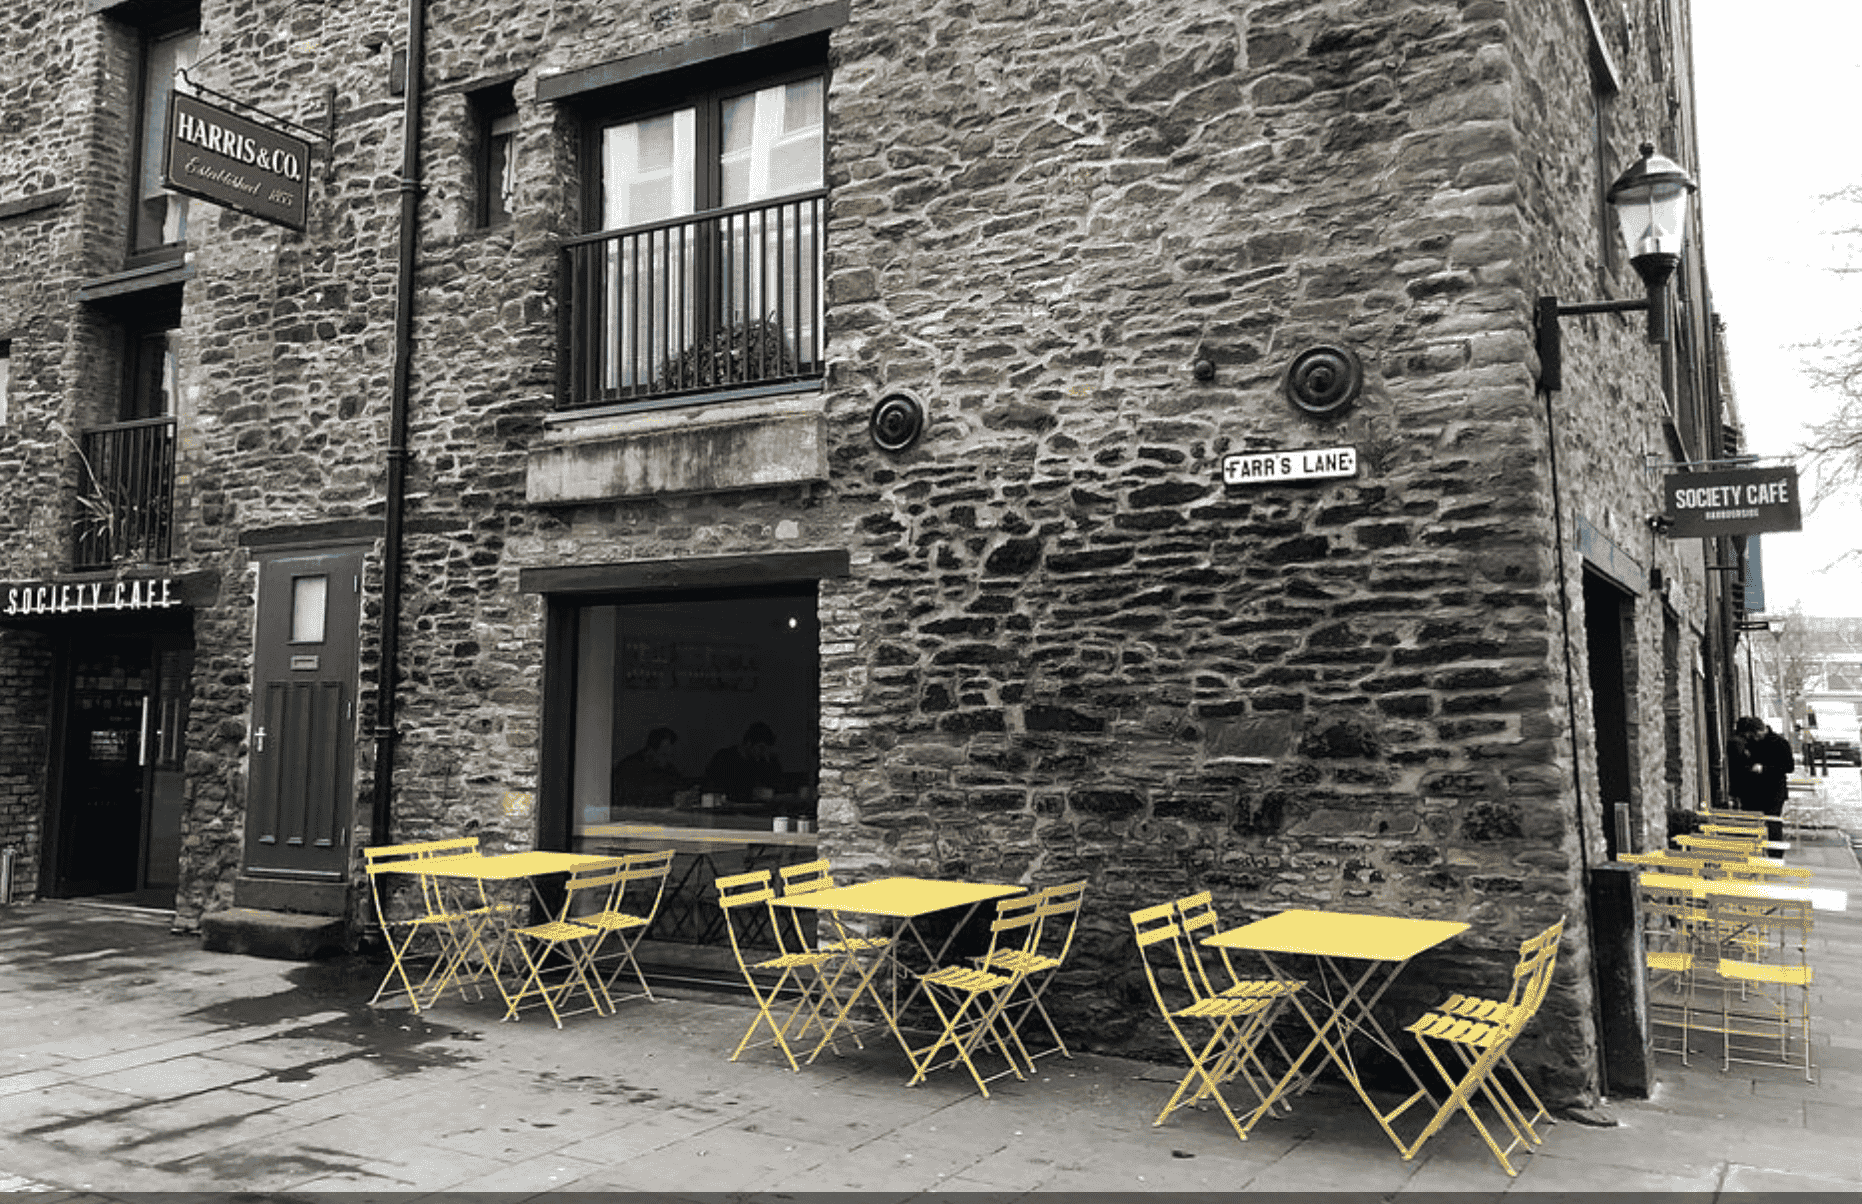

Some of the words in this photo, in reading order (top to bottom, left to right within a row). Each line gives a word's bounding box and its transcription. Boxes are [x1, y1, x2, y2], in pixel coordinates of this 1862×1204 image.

[1303, 453, 1350, 473] LANE
[1675, 485, 1741, 509] SOCIETY
[1746, 477, 1789, 505] CAFÉ
[9, 583, 101, 615] SOCIETY
[115, 579, 171, 610] CAFE
